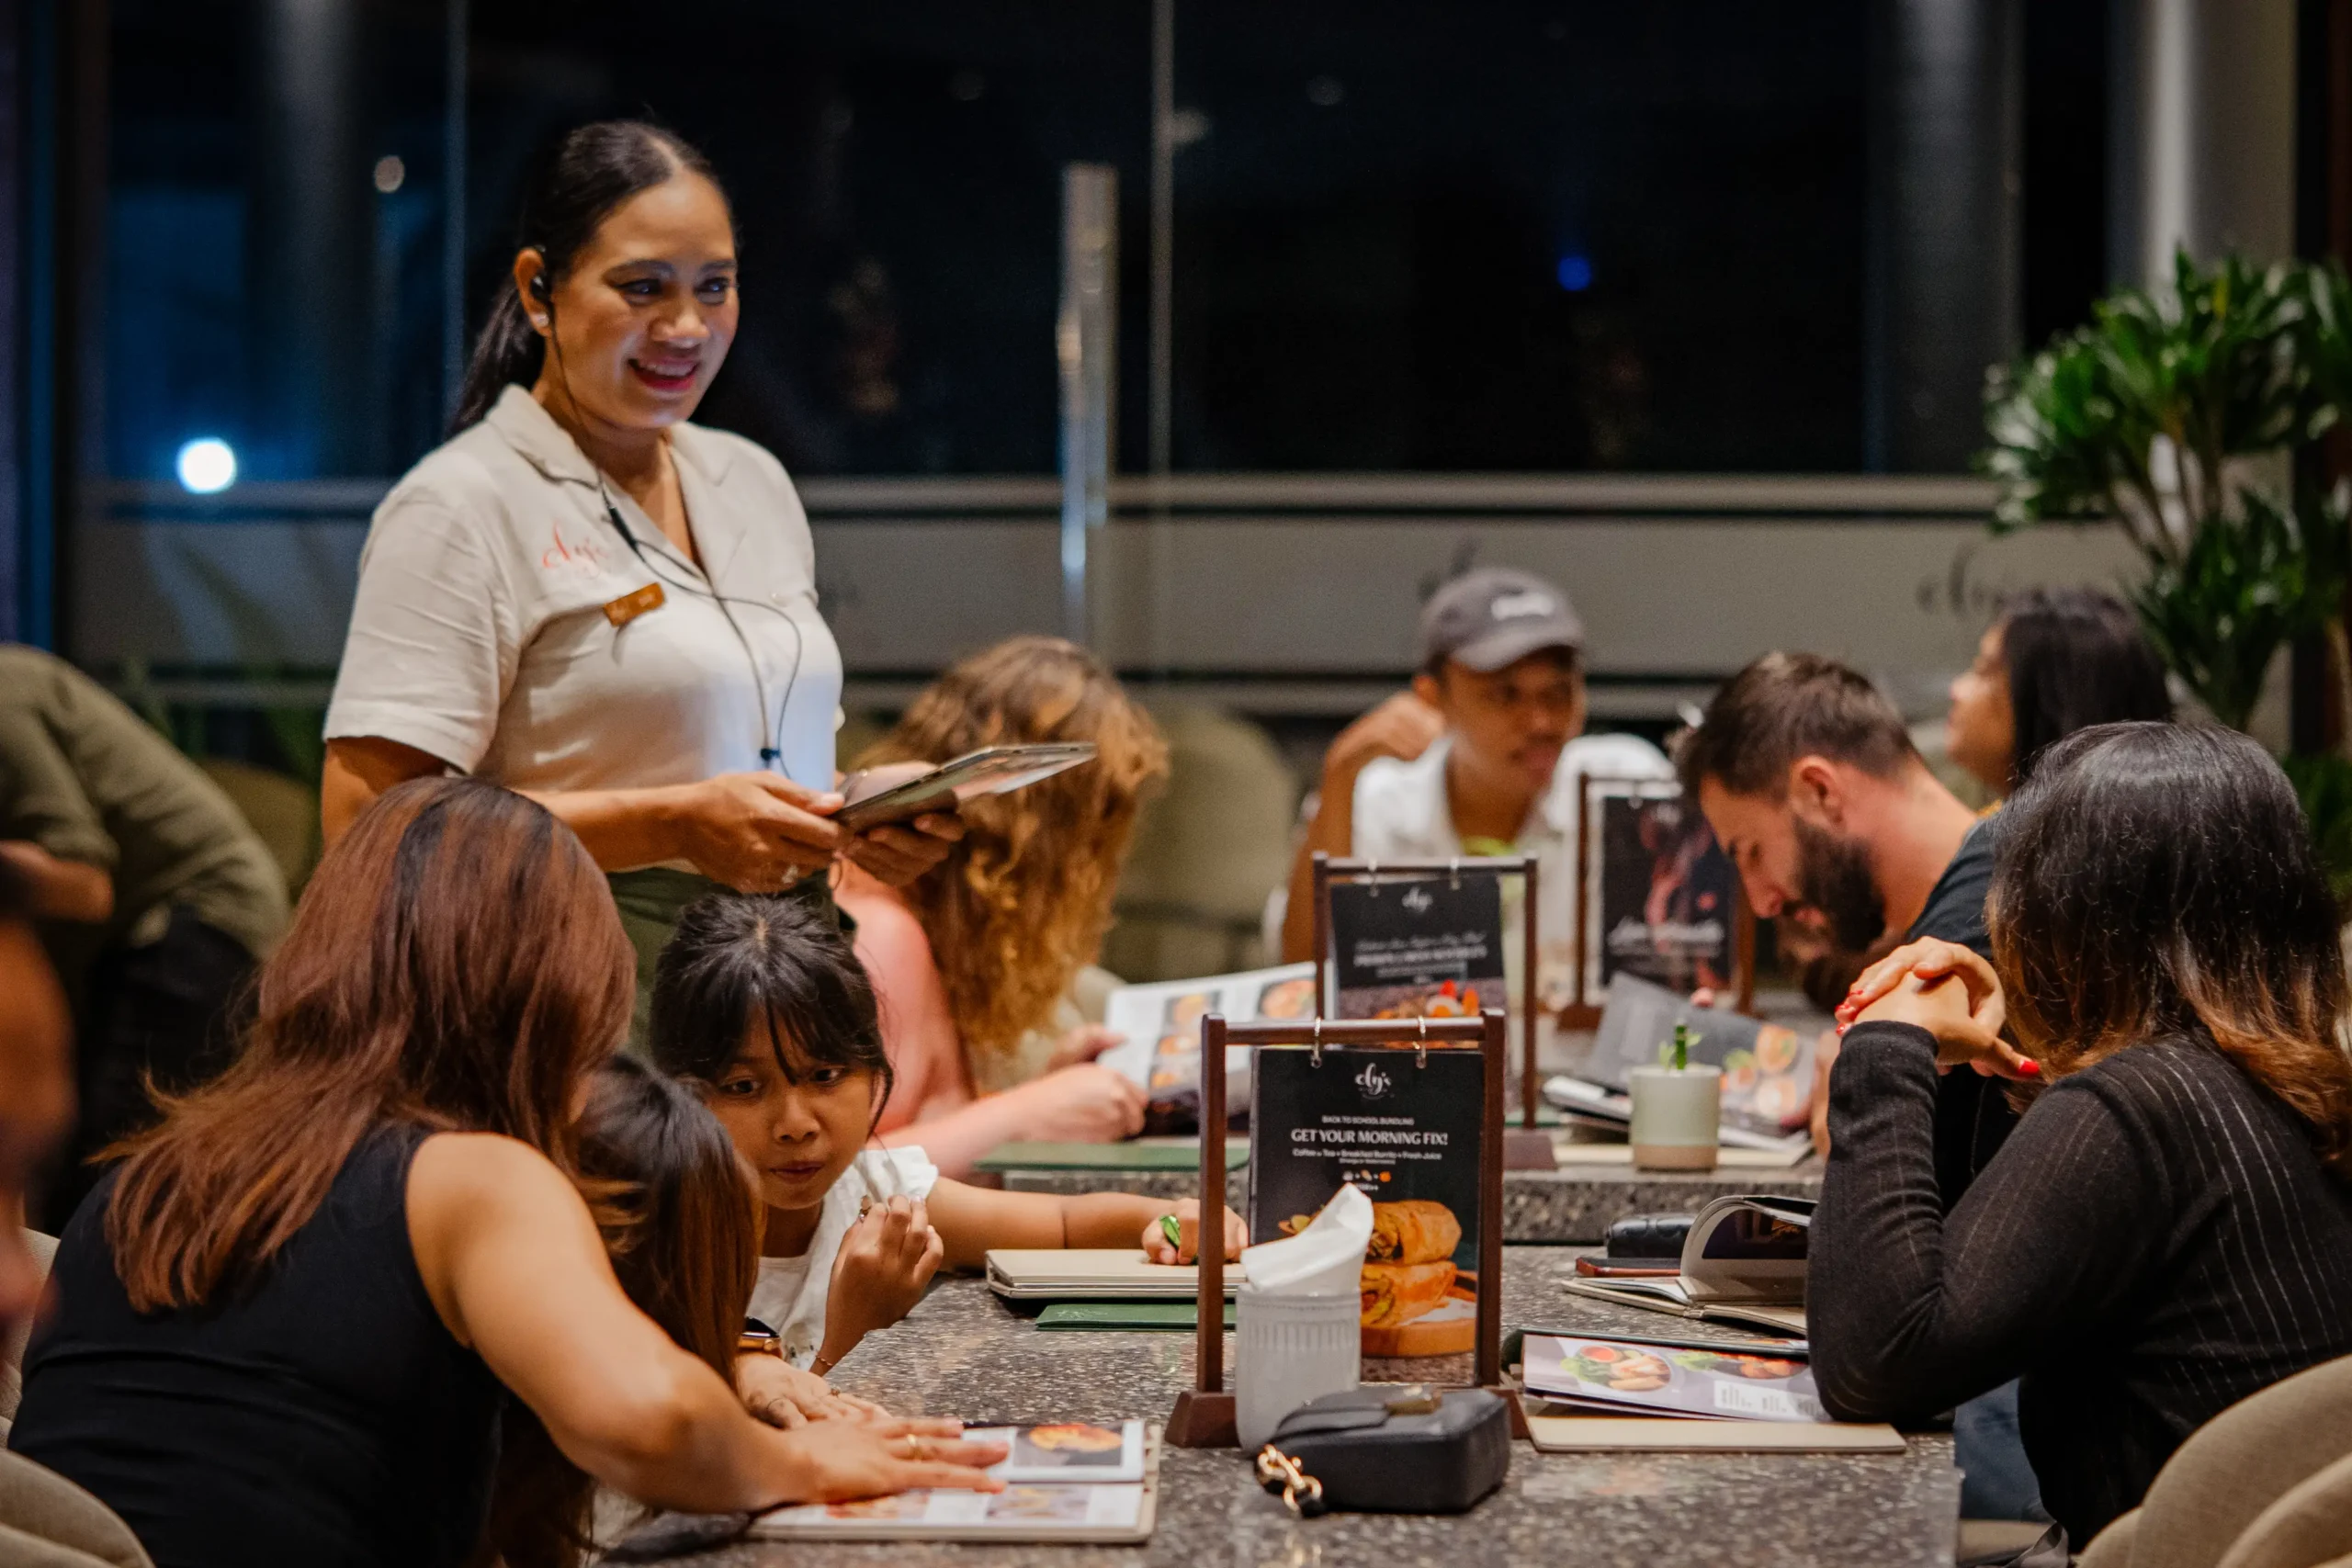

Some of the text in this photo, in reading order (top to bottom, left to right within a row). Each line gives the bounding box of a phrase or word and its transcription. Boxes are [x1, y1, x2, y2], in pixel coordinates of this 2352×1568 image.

[1341, 1116, 1351, 1124] TO
[1352, 1116, 1378, 1125] SCHOOL
[1291, 1128, 1448, 1145] GET YOUR MORNING FIX!
[1293, 1147, 1316, 1156] Coffee
[1323, 1148, 1336, 1156] Tea
[1341, 1149, 1374, 1157] Breakfast
[1374, 1150, 1396, 1158] Burrito
[1402, 1151, 1421, 1159] Fresh
